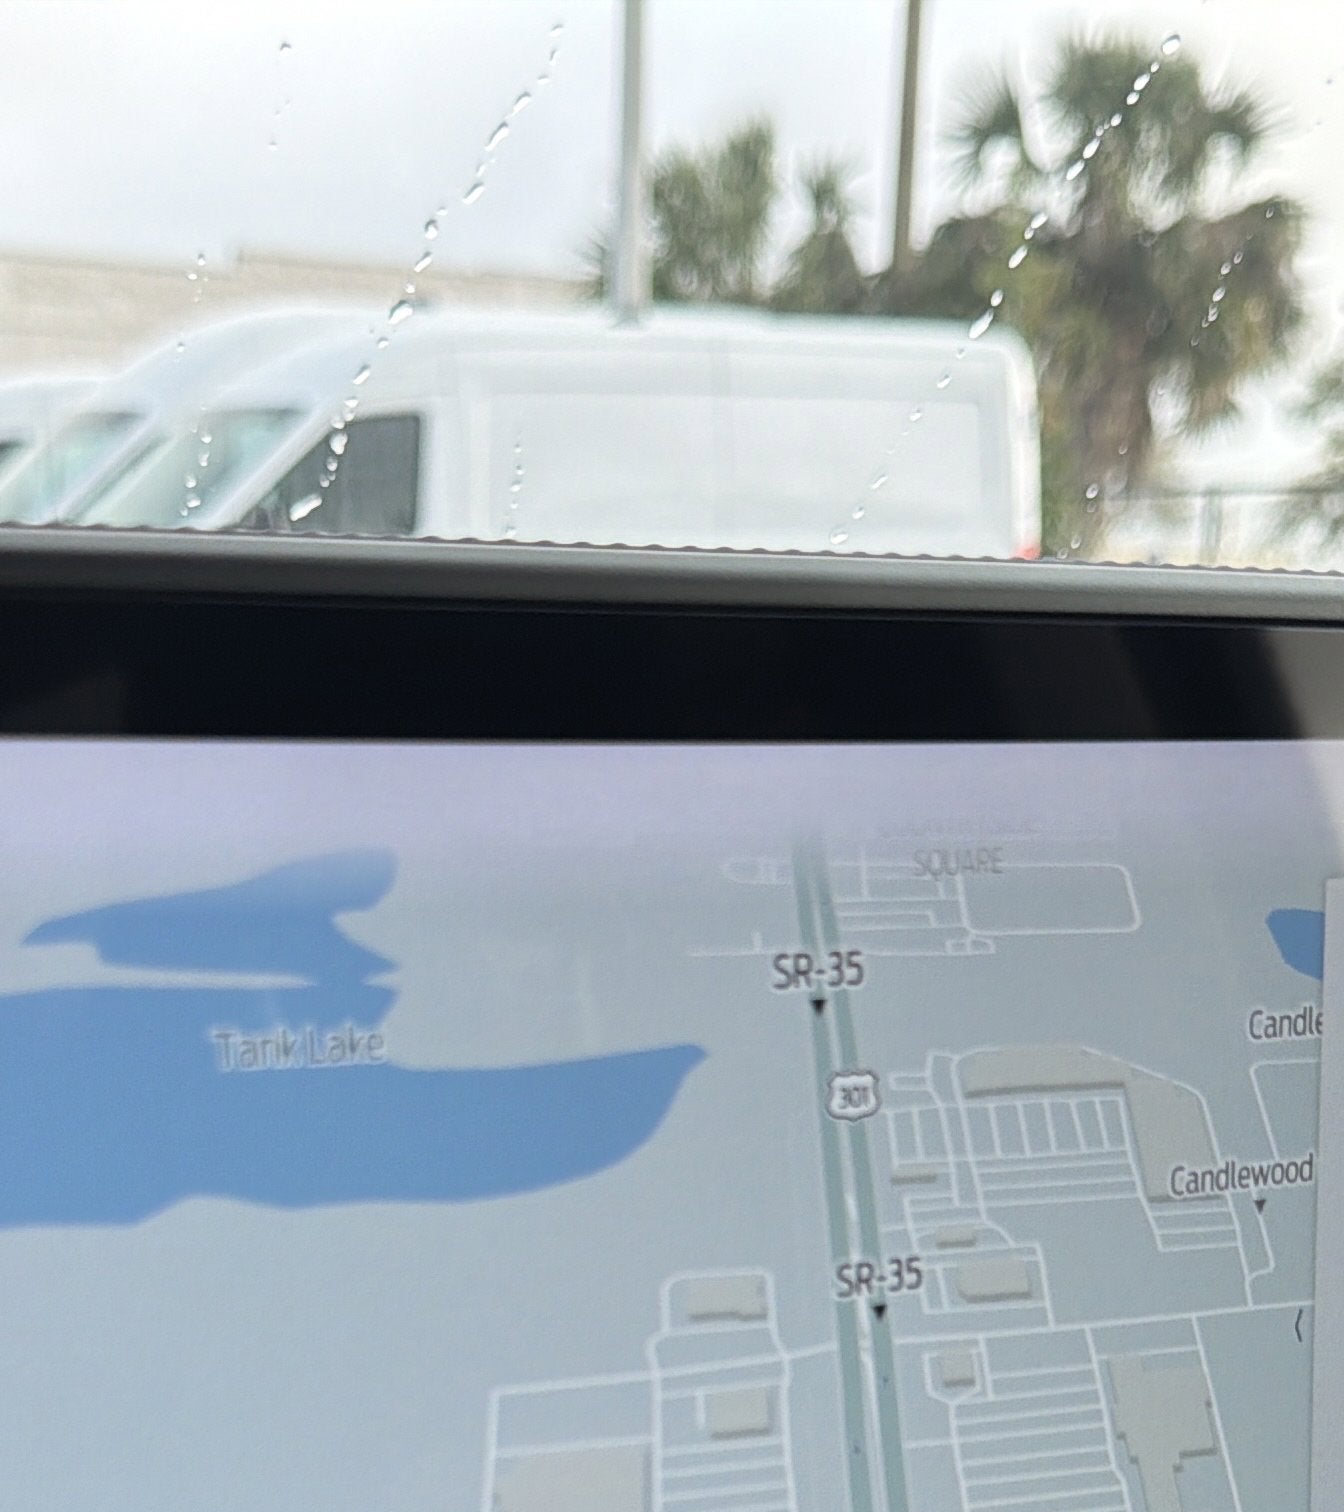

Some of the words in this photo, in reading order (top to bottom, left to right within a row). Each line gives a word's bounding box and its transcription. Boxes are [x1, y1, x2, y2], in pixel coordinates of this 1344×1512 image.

[913, 848, 1003, 881] SQUARE
[772, 952, 864, 990] SR-35
[307, 1023, 384, 1065] Lake
[1169, 1154, 1314, 1196] Candlewood
[836, 1257, 924, 1297] SR-35
